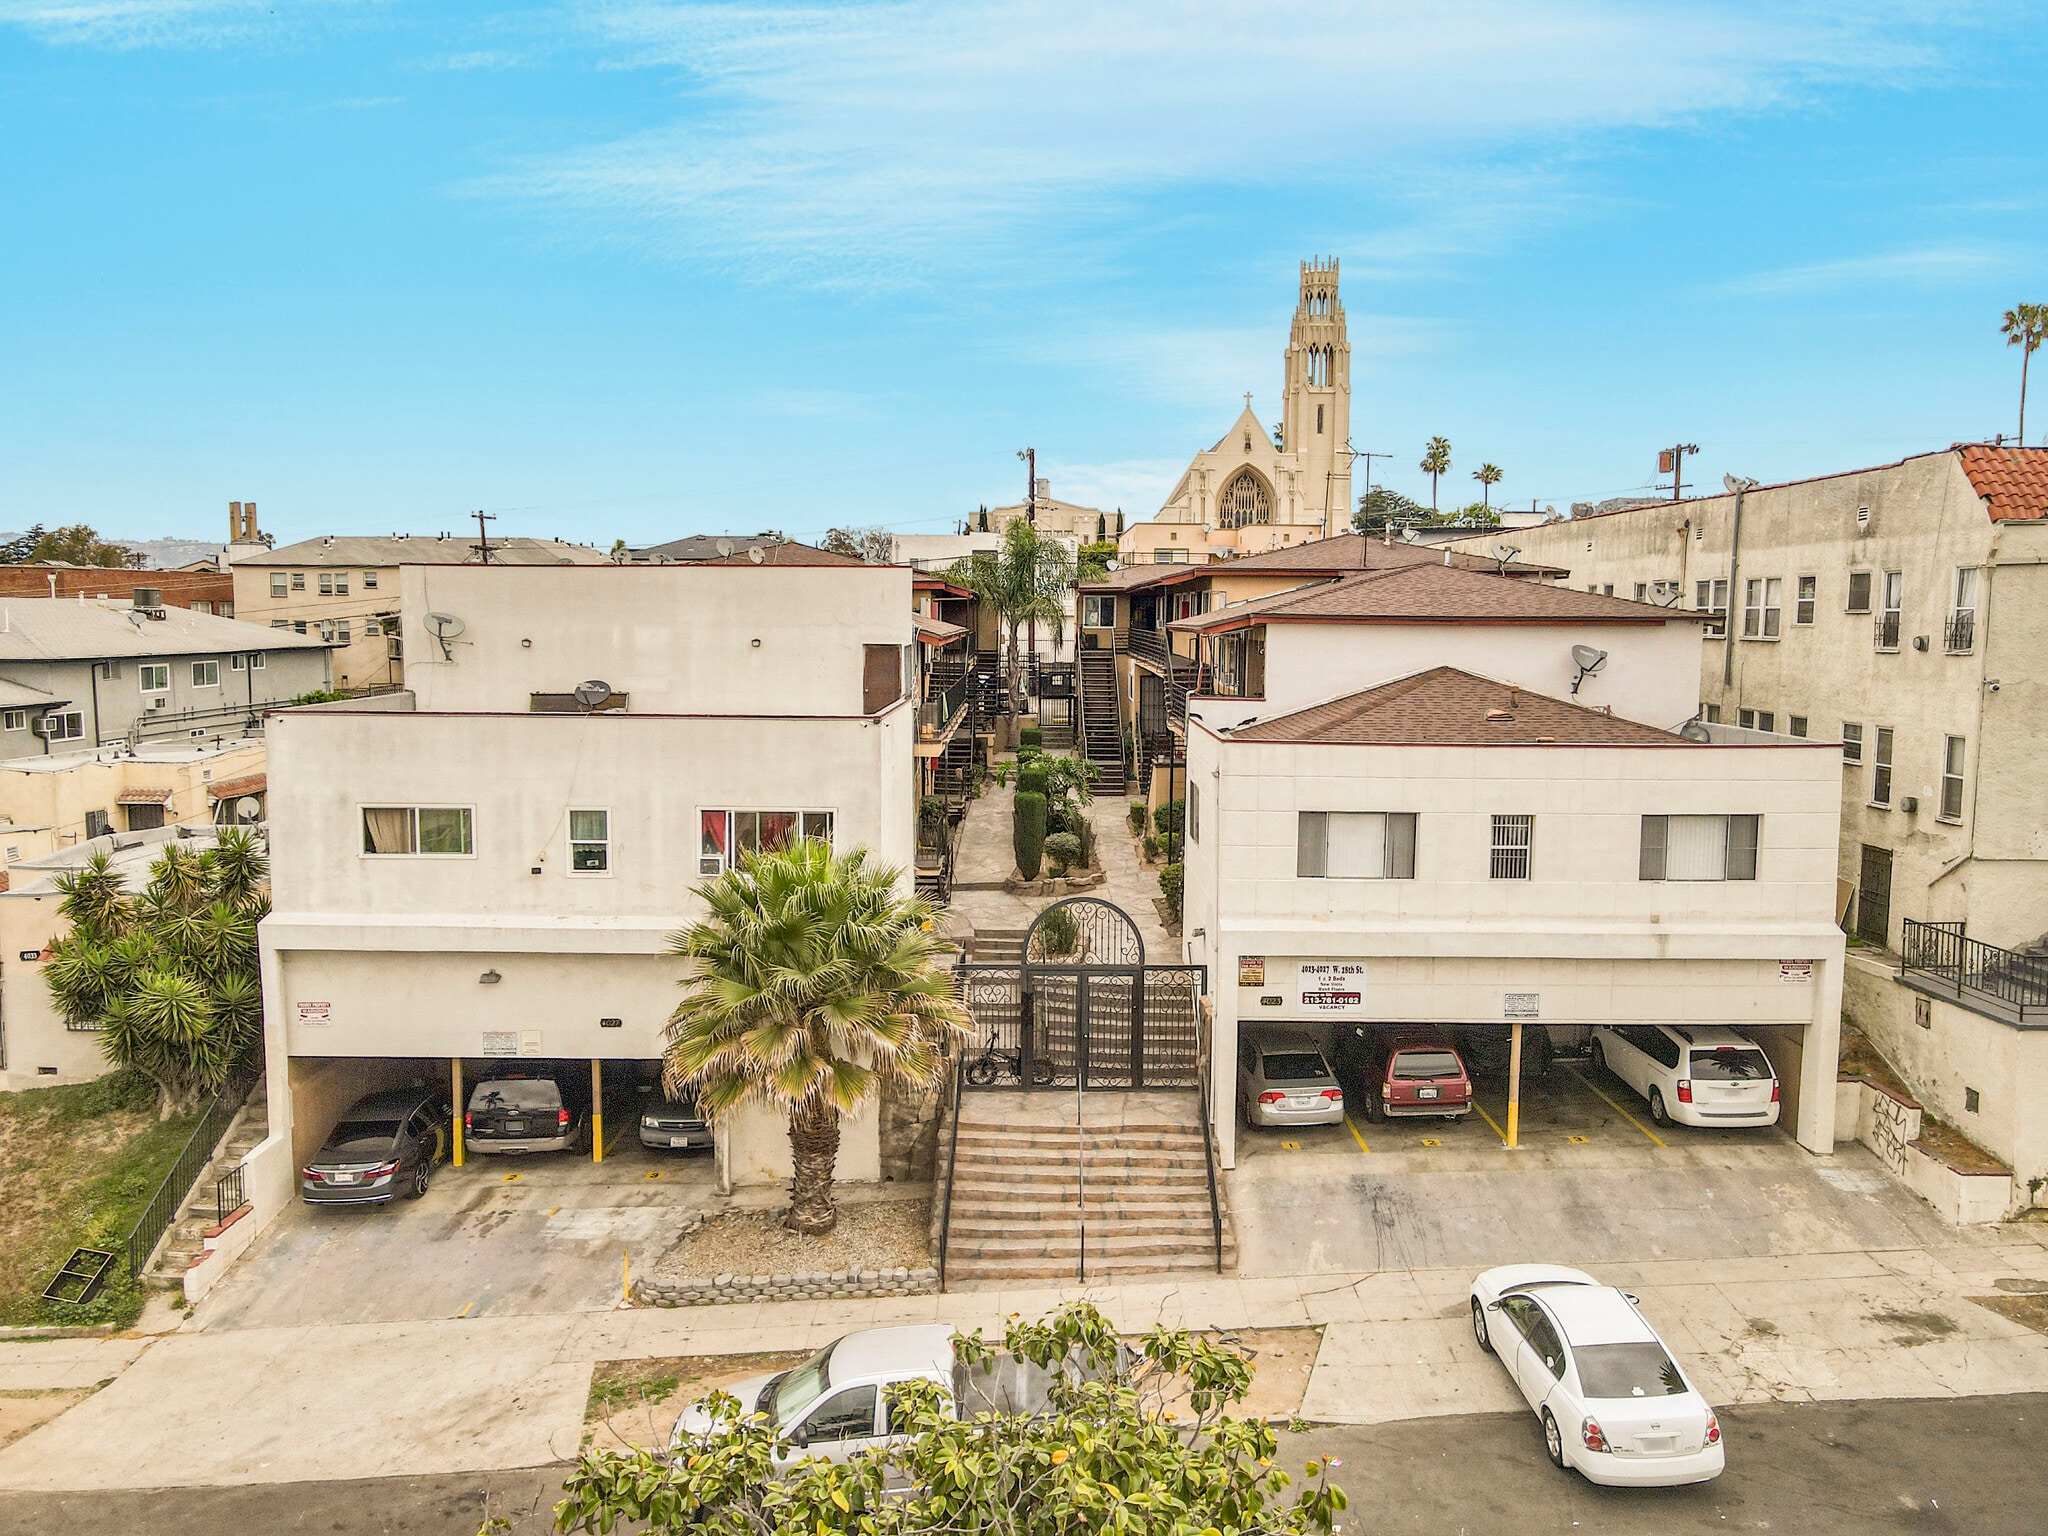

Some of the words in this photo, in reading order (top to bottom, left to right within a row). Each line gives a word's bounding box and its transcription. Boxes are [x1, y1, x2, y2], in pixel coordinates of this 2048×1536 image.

[1301, 965, 1330, 974] 4023-4027
[1332, 965, 1340, 974] W.
[1355, 965, 1364, 974] St.
[1262, 997, 1281, 1005] 4023
